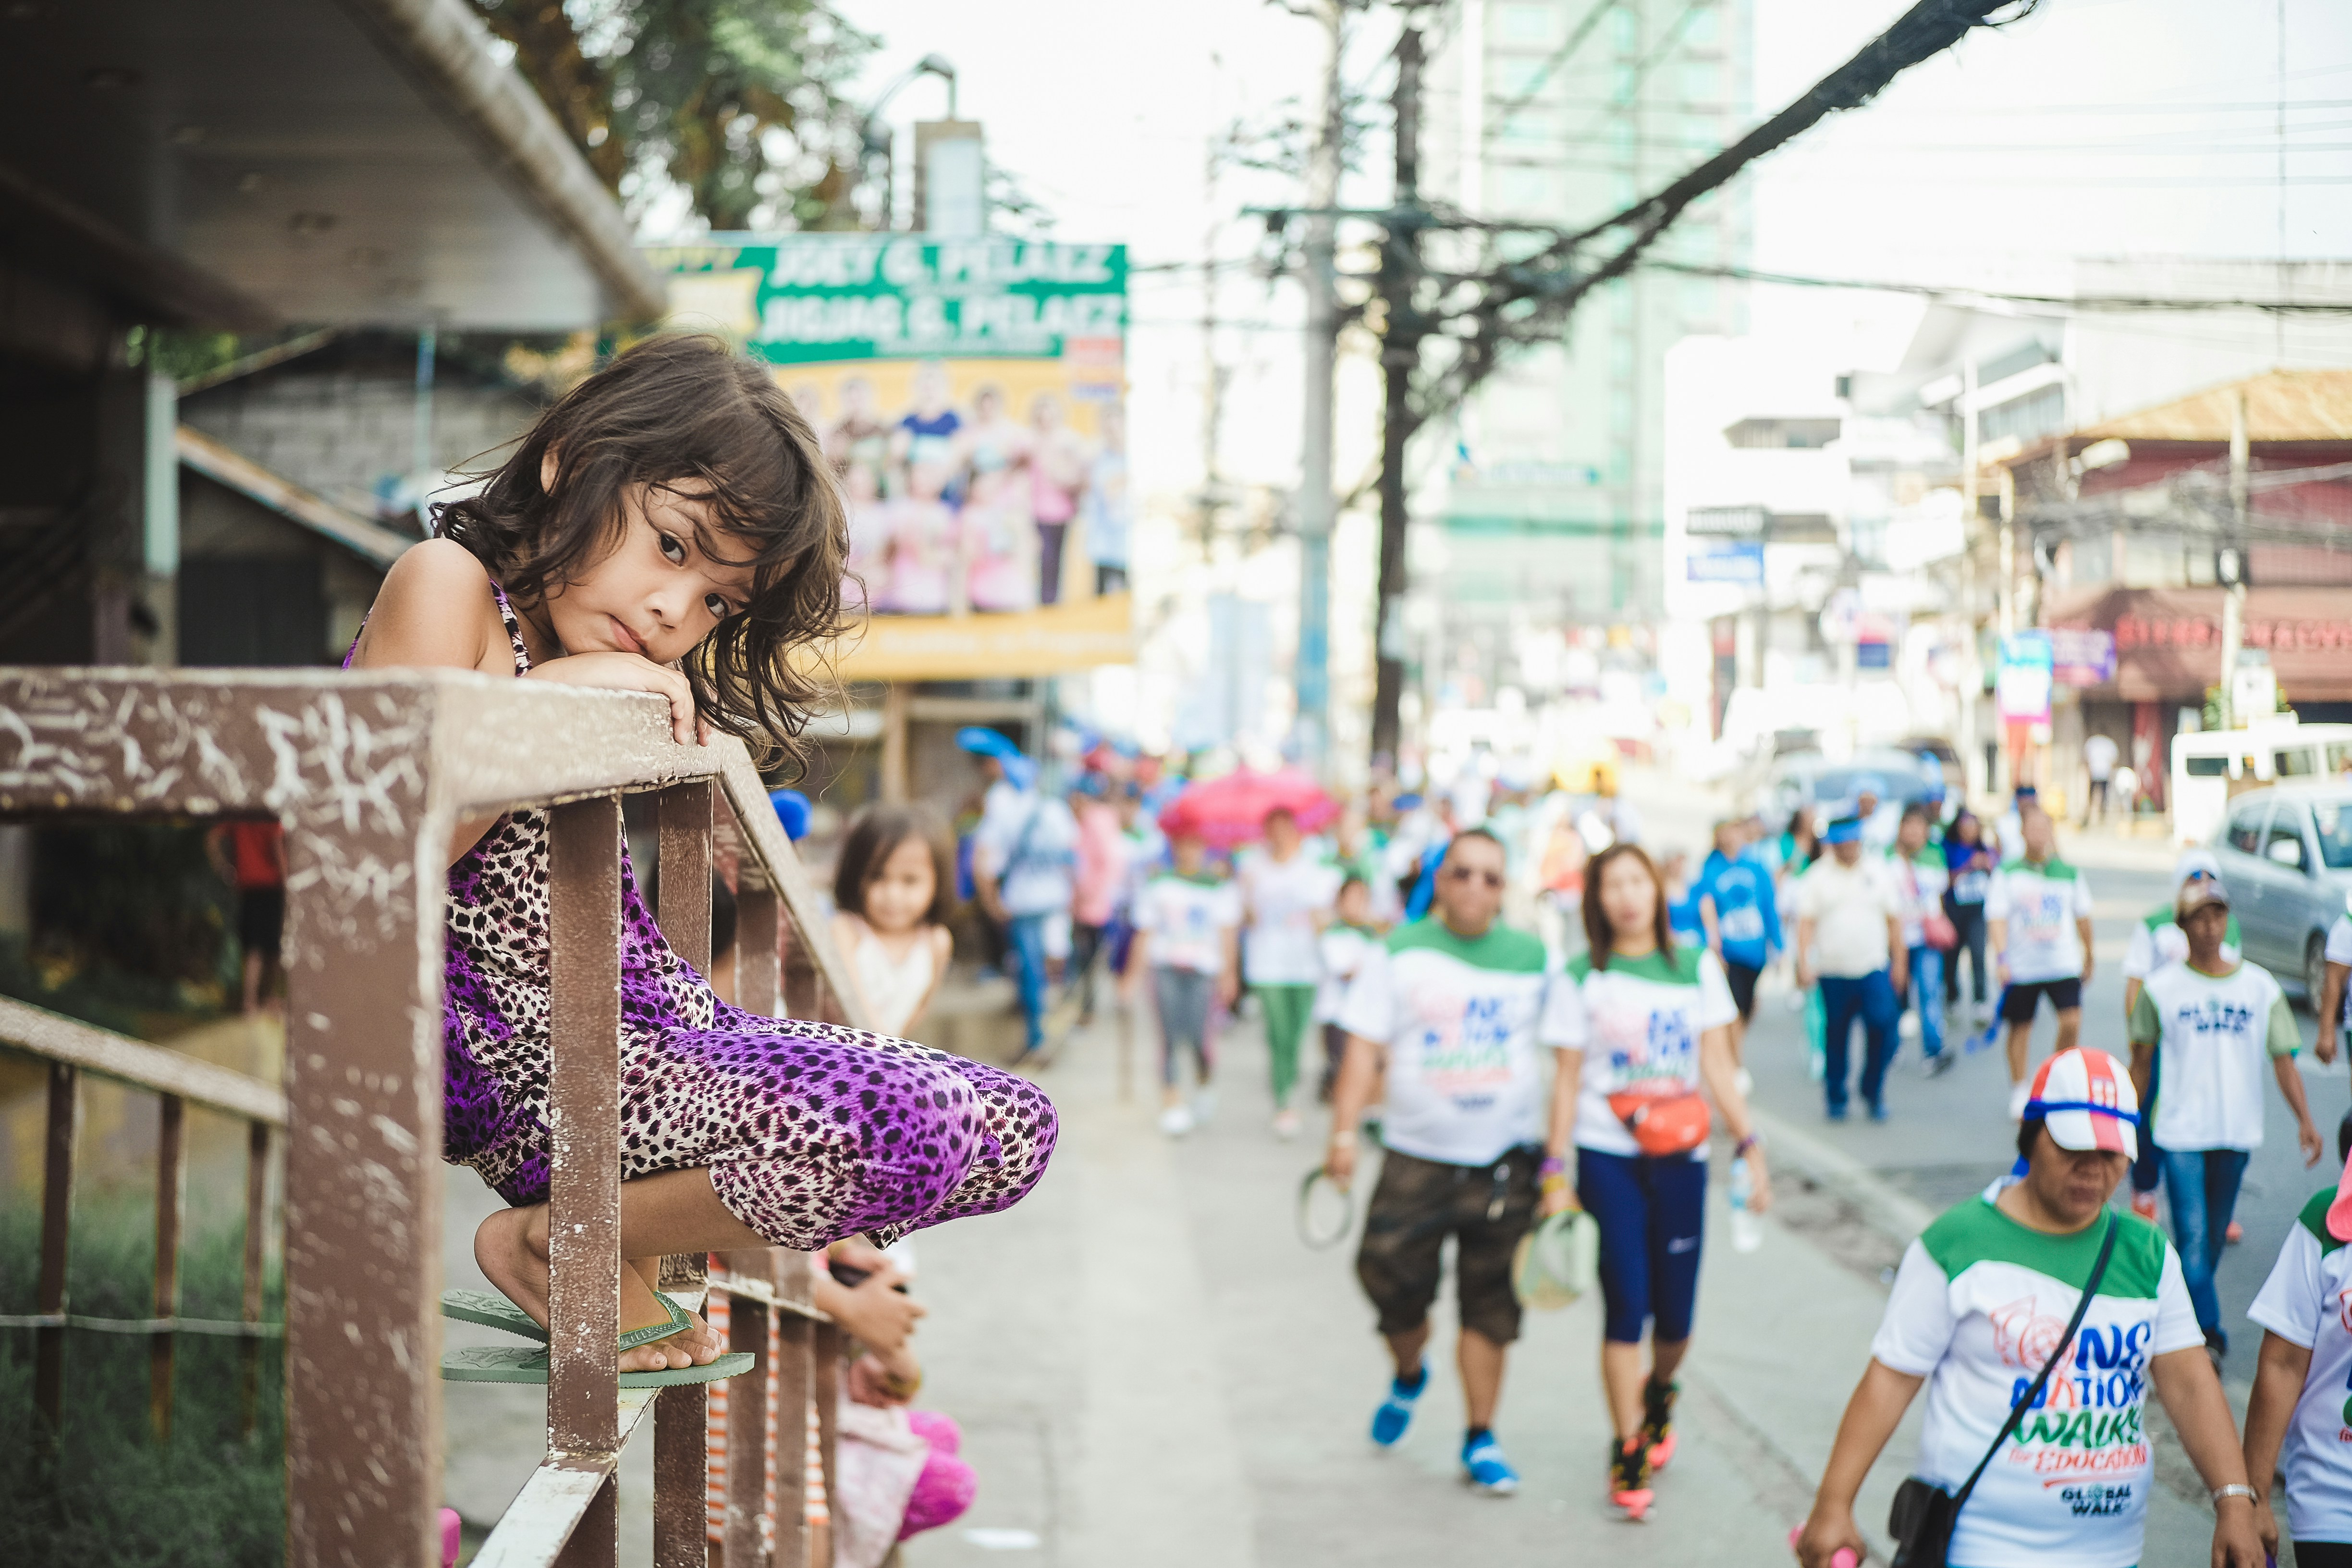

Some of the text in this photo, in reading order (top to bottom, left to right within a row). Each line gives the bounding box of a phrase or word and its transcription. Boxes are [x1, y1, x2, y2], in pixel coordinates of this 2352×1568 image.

[769, 239, 880, 287] JOEY
[938, 240, 1114, 284] PELAEZ
[959, 294, 1124, 338] PELAEZ
[2035, 1443, 2147, 1474] EDUCATION
[2061, 1483, 2132, 1501] GLOBAL
[2071, 1501, 2123, 1518] WALK
